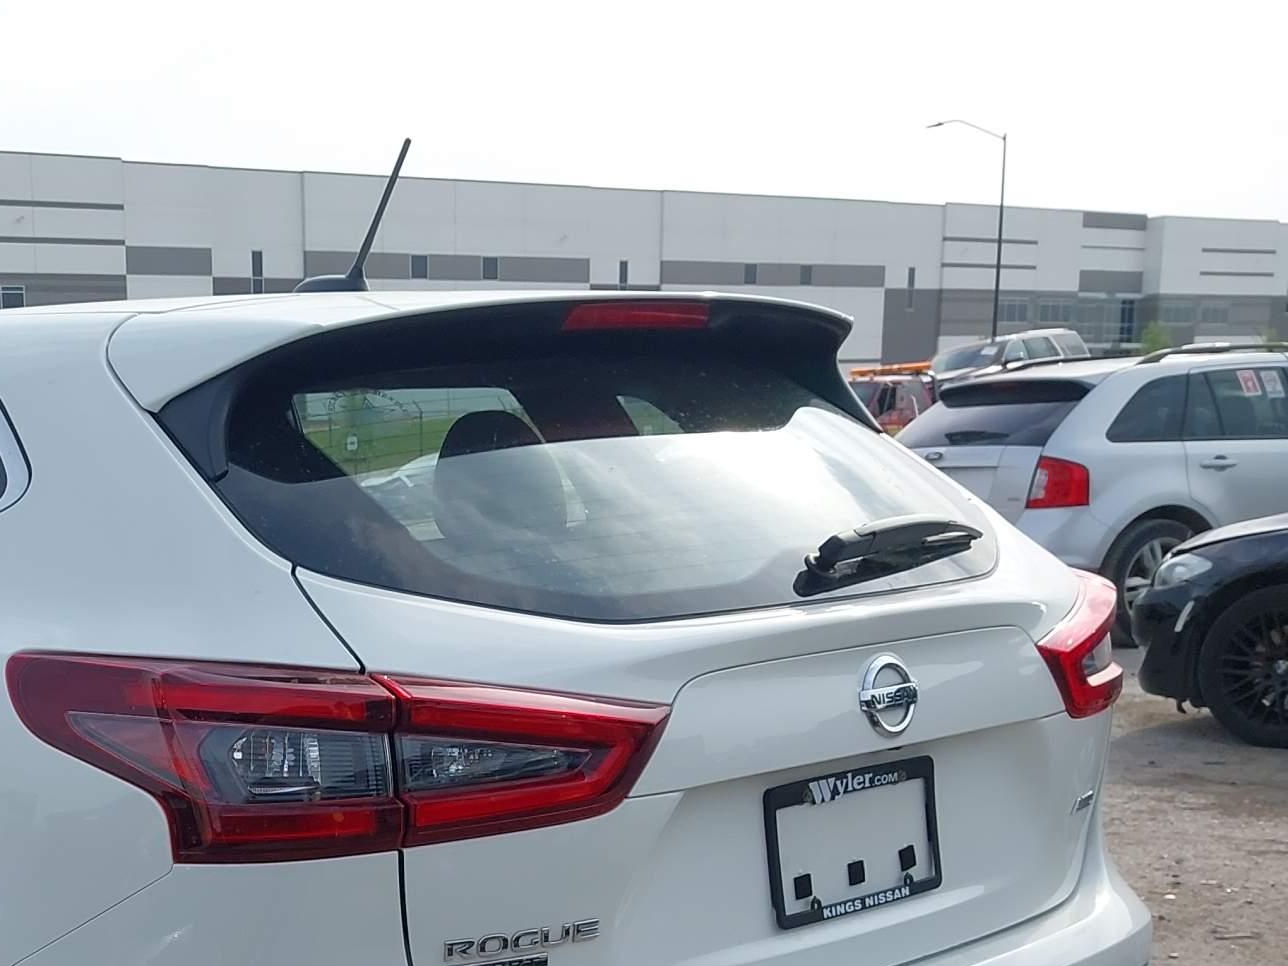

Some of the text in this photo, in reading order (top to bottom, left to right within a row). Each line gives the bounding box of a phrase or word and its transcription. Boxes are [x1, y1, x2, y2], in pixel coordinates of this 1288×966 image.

[870, 686, 916, 707] NISSAN
[823, 887, 910, 919] KINGS NISSAN
[443, 917, 600, 962] ROGUE
